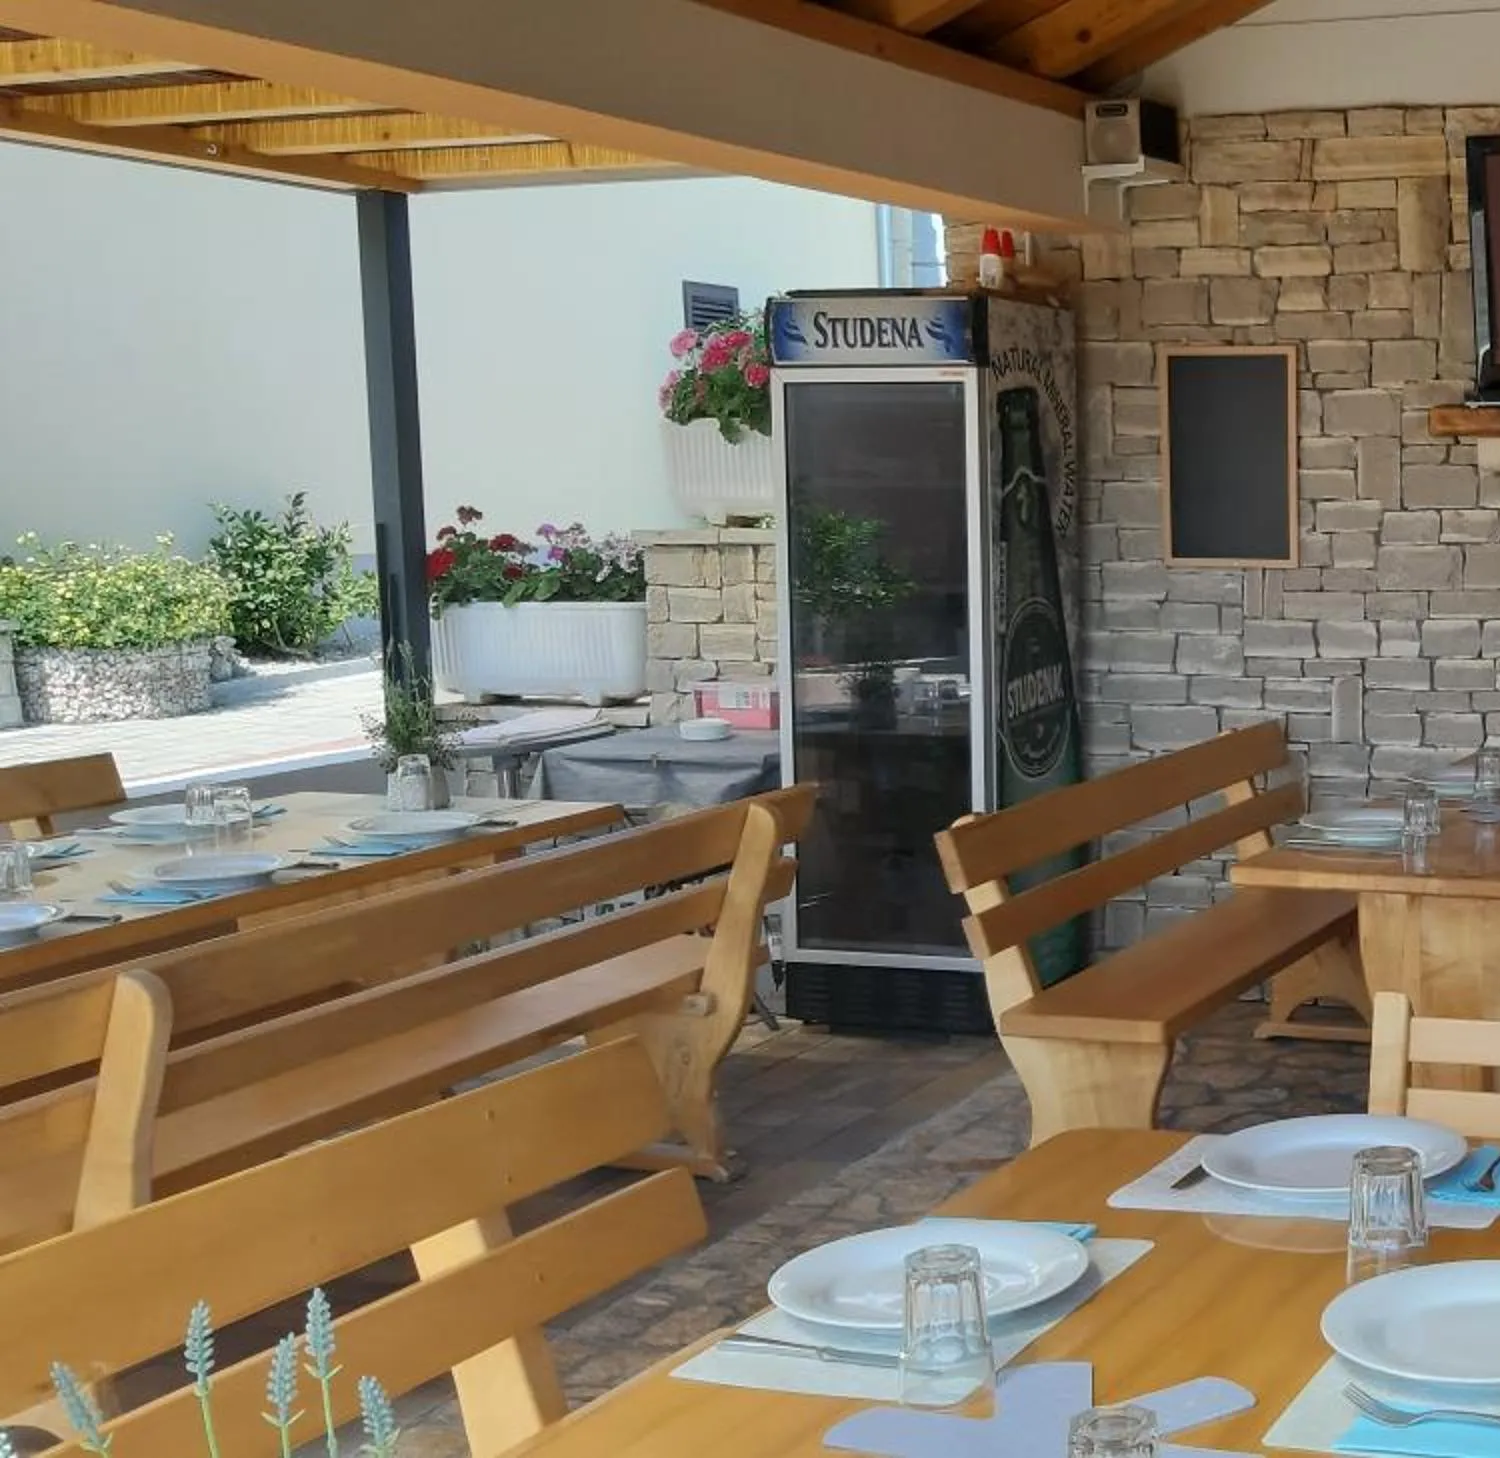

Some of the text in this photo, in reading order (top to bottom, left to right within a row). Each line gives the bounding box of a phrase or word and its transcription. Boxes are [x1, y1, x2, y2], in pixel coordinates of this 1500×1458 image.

[813, 311, 925, 351] STUDENA
[991, 346, 1076, 539] NATURAL MINERAL WATER
